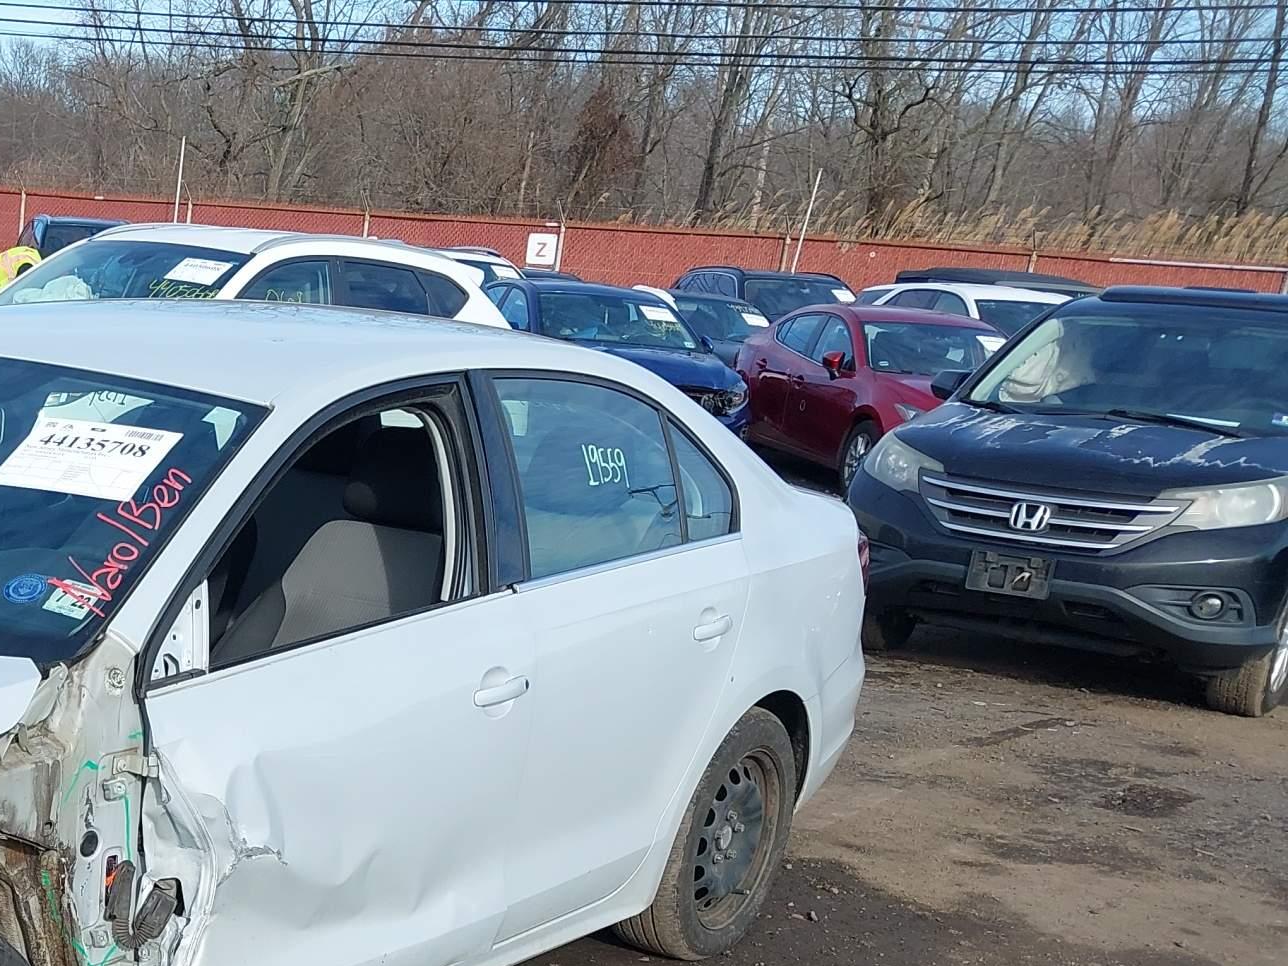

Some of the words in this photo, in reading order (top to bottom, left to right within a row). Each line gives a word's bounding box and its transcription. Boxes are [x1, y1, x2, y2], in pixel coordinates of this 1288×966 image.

[535, 242, 548, 257] Z
[39, 433, 151, 459] 44135708
[580, 443, 630, 488] 19559
